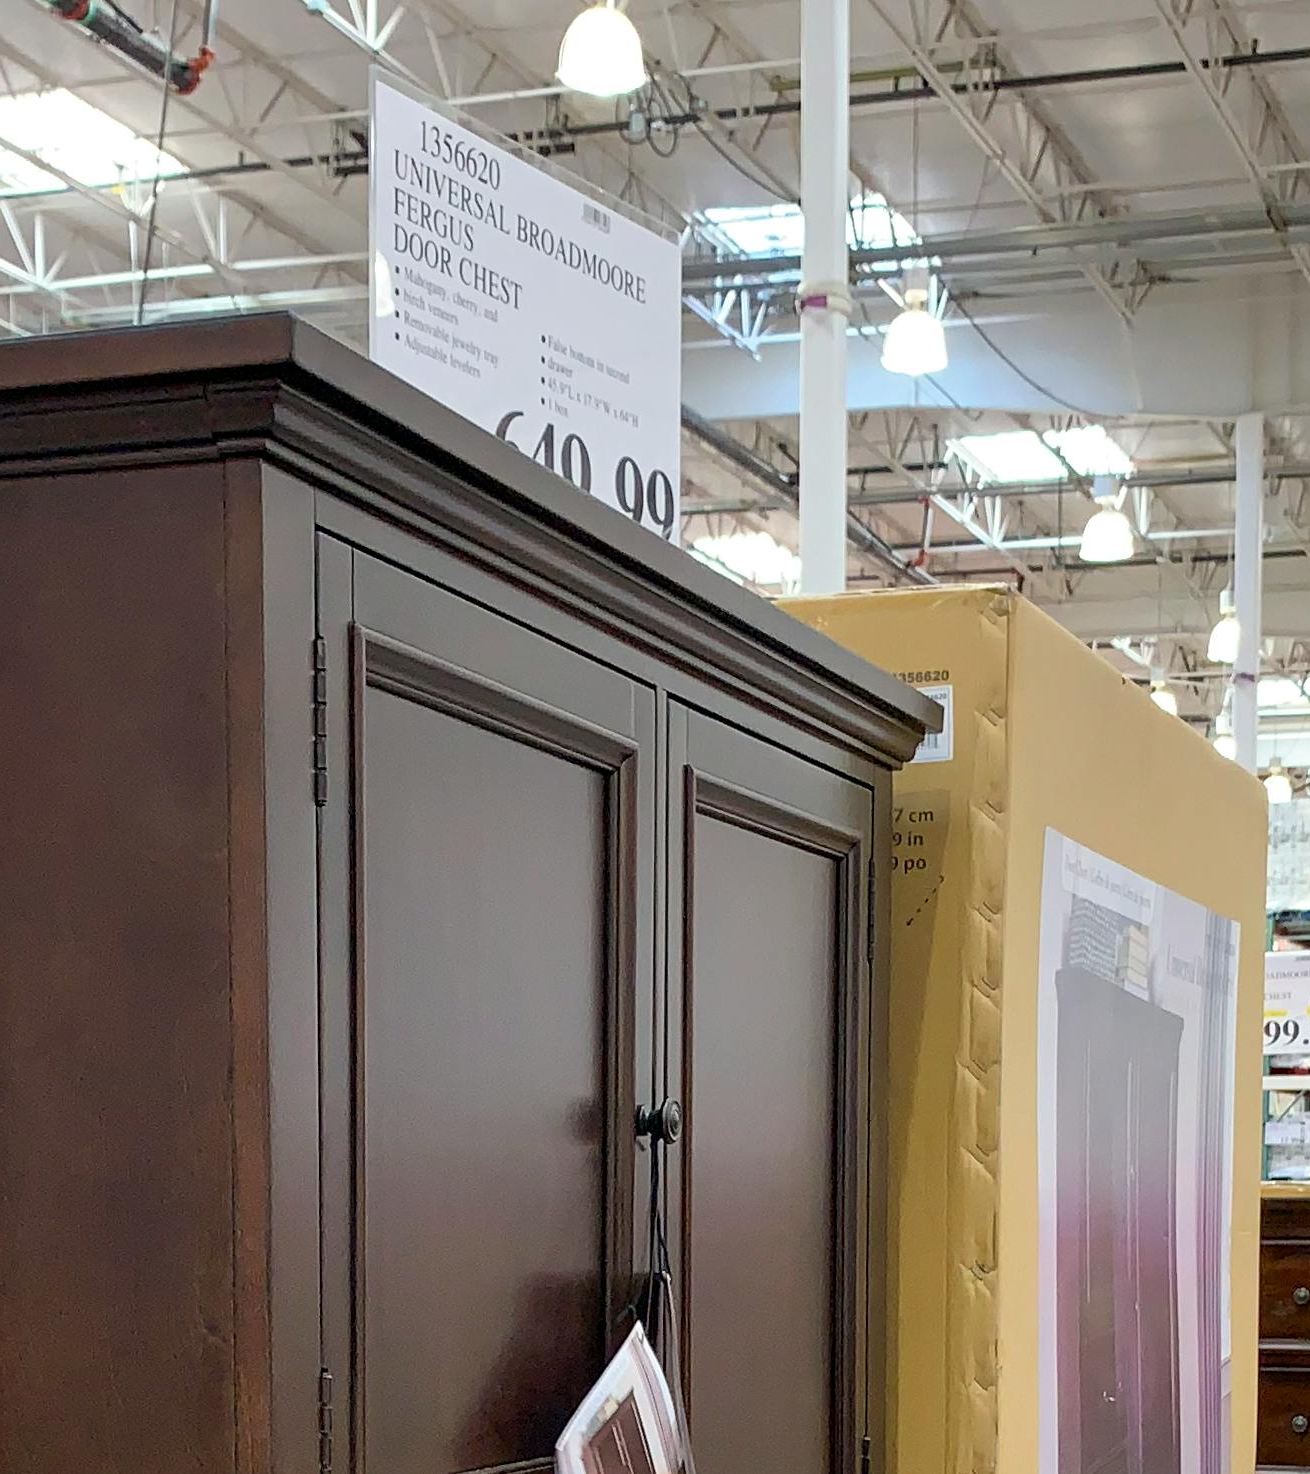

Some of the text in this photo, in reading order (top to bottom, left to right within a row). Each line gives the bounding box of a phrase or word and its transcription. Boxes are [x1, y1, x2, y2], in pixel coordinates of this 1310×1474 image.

[421, 121, 501, 190] 1356620
[394, 187, 474, 251] FERGUS
[395, 149, 646, 304] UNIVERSAL BROADMOORE
[394, 223, 522, 310] DOOR CHEST
[403, 288, 458, 325] birch veneers
[484, 308, 498, 322] and
[404, 310, 498, 369] Removable jewelry tray
[548, 335, 567, 358] False
[404, 333, 481, 379] Adjustable levelers
[548, 358, 573, 378] drawer
[555, 400, 568, 419] box
[892, 670, 949, 683] 356620
[909, 809, 934, 823] cm
[908, 832, 924, 846] in
[904, 857, 926, 874] po
